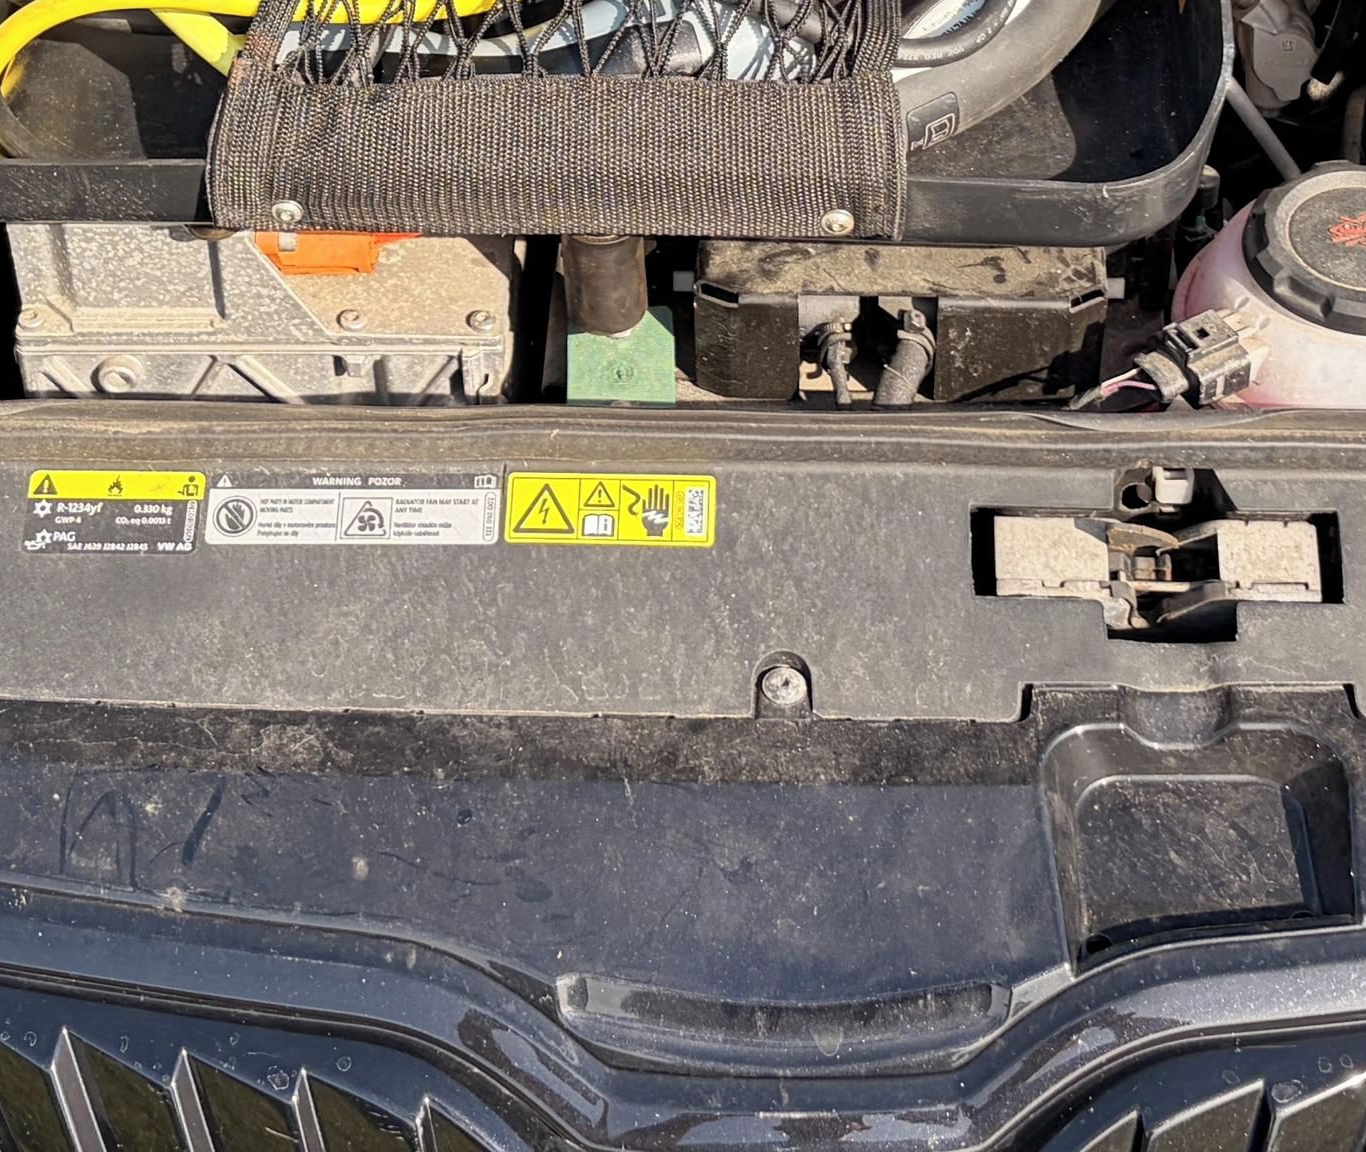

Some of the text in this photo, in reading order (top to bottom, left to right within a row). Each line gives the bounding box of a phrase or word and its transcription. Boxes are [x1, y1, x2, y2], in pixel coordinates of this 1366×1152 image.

[311, 476, 403, 486] WARNING POZOR
[57, 502, 173, 516] R-1234yf 0.330 kg
[52, 531, 76, 542] PAG
[67, 542, 83, 551] SAE
[157, 542, 175, 551] VW
[176, 542, 193, 551] AG
